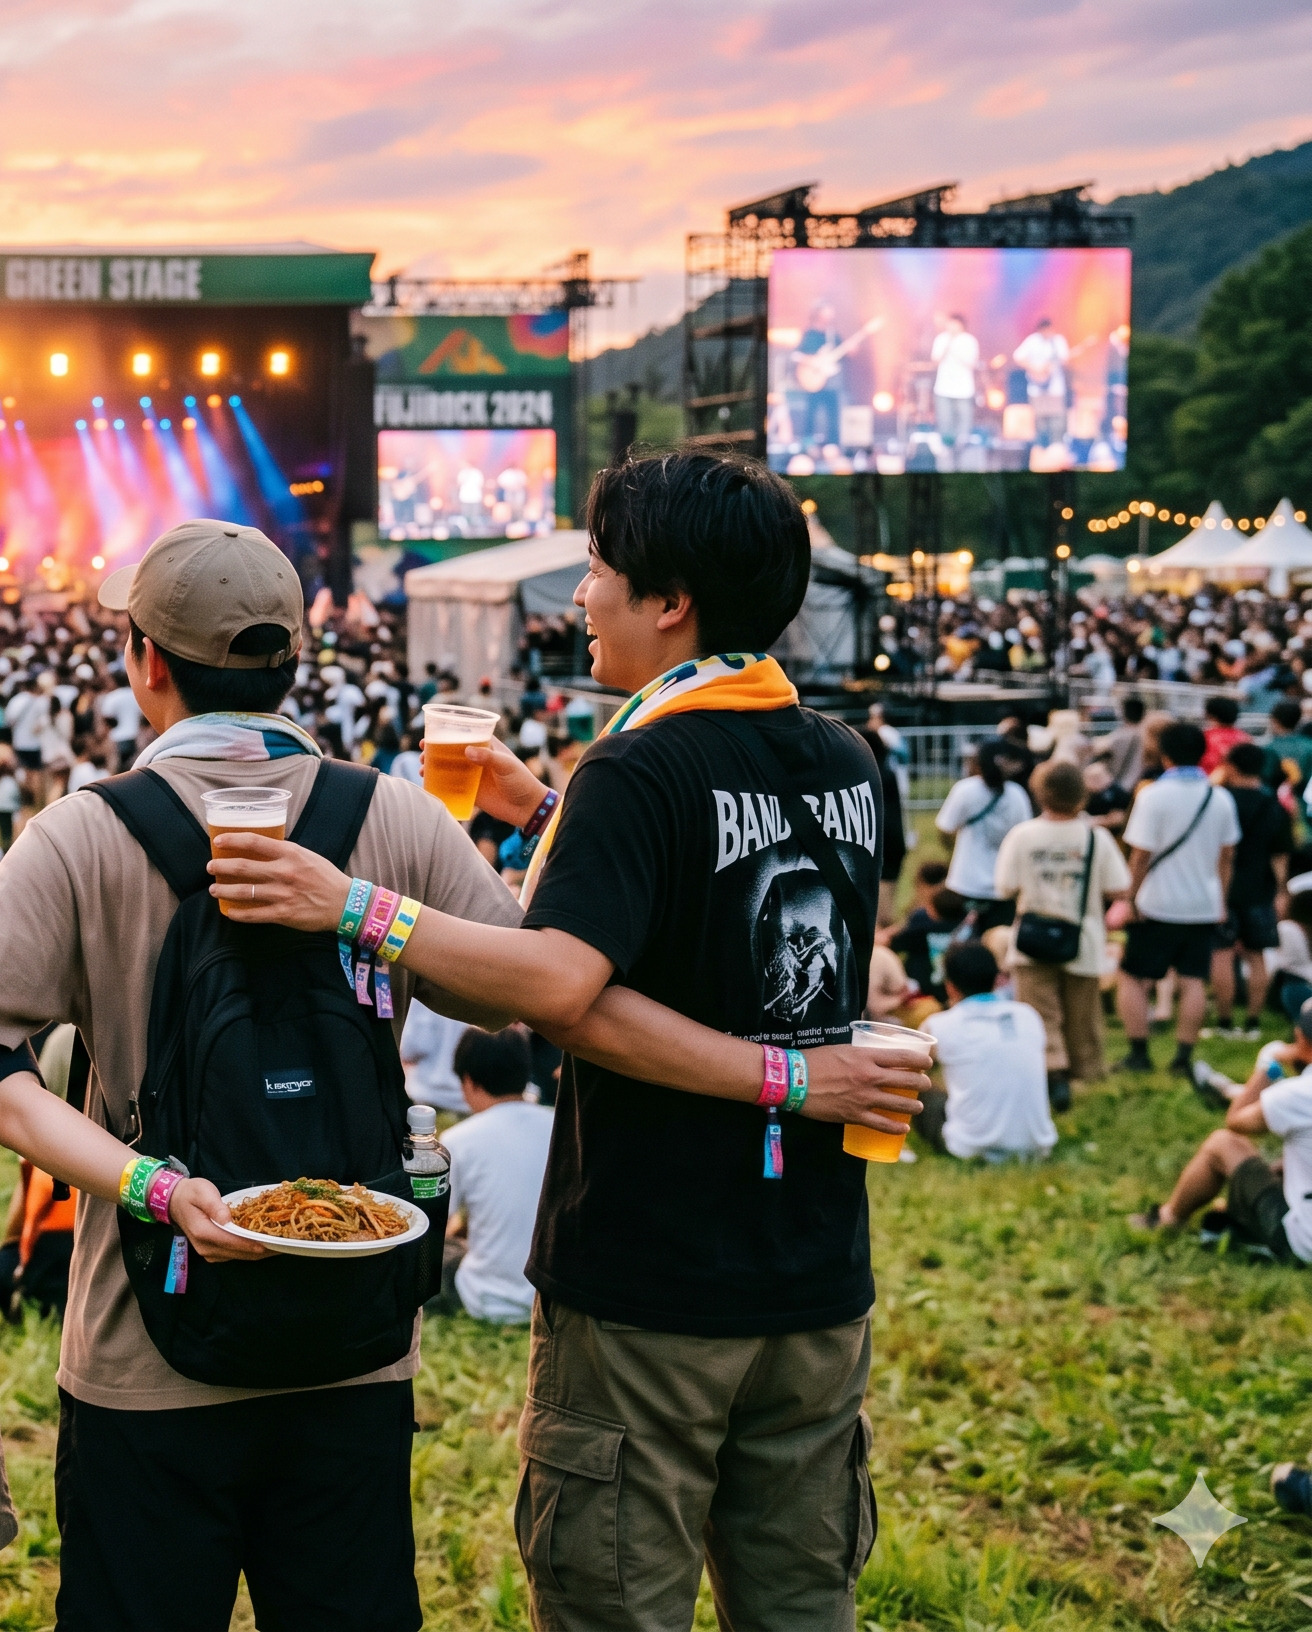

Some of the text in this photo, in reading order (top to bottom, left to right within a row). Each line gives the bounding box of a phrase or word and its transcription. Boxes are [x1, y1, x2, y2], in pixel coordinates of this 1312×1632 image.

[6, 258, 201, 301] GREEN STAGE
[373, 389, 553, 427] FUJIROCK 2024
